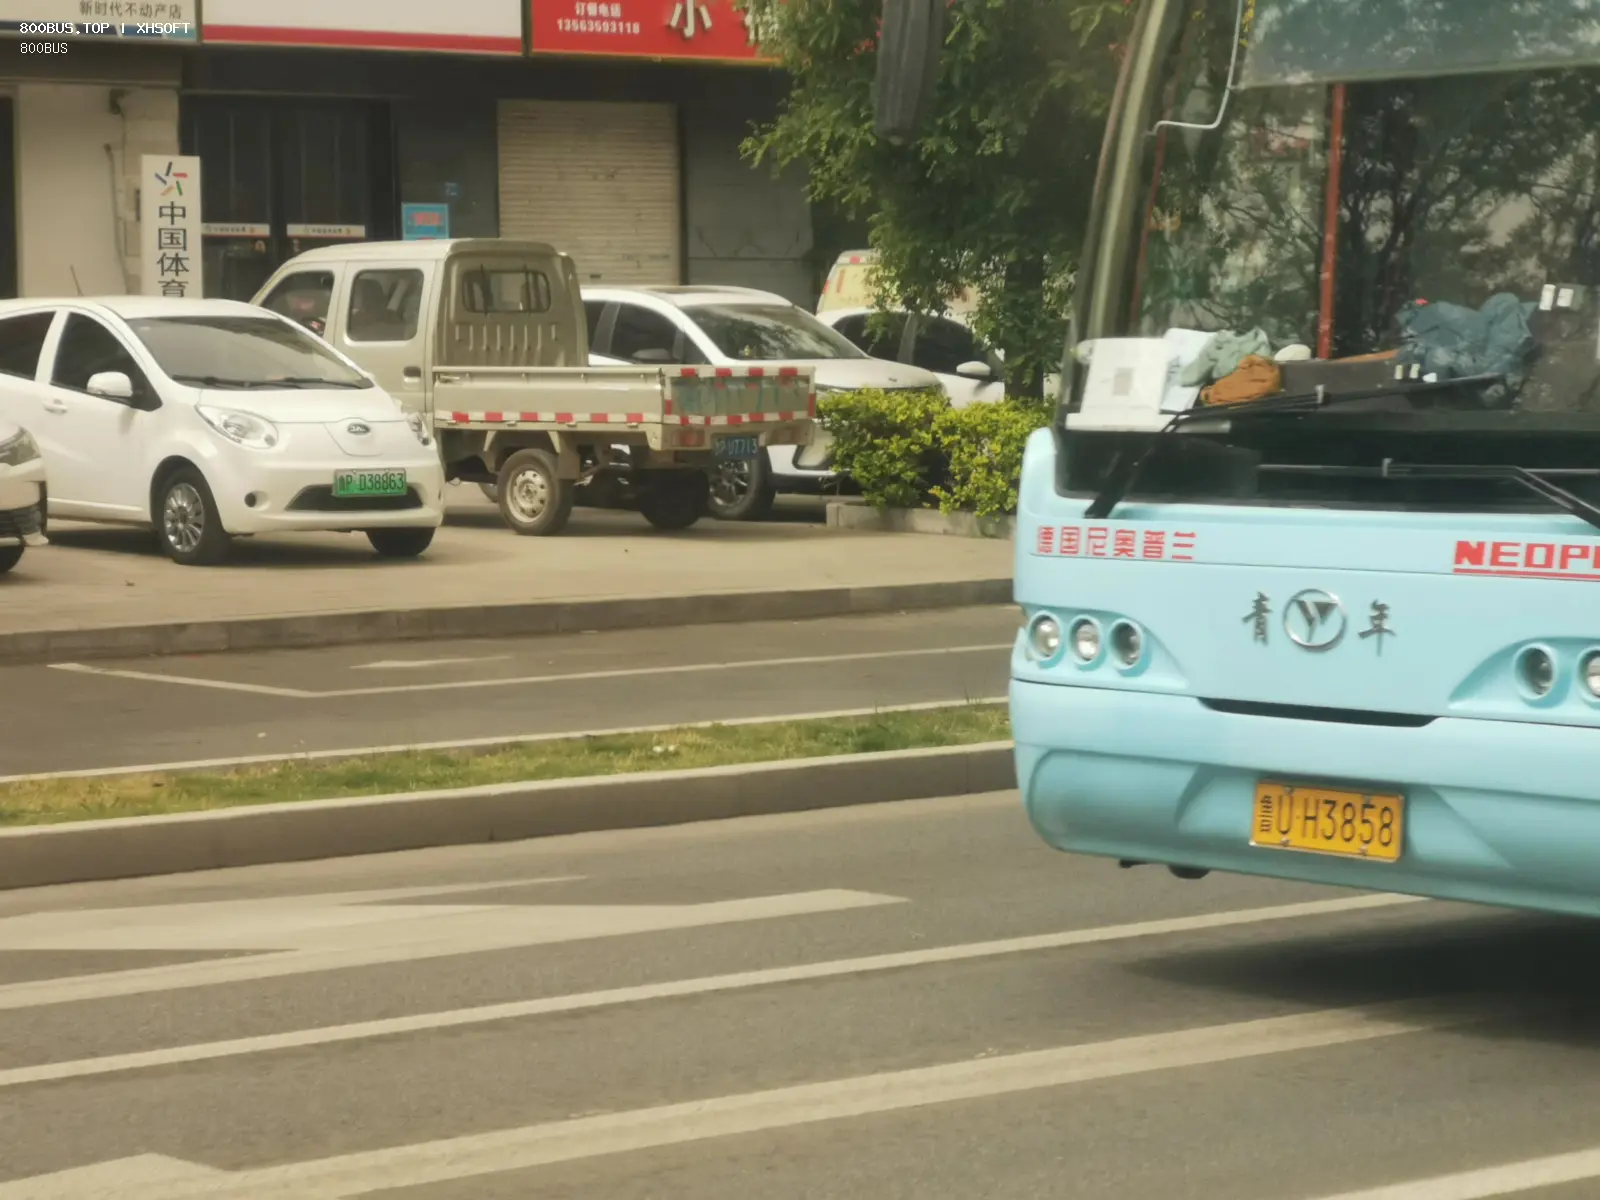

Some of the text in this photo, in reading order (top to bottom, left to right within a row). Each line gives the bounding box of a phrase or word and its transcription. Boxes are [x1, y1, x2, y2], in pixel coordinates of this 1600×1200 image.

[79, 1, 182, 19] 新时代不动产店
[157, 201, 190, 297] 中国体育
[1454, 540, 1600, 570] NEOP
